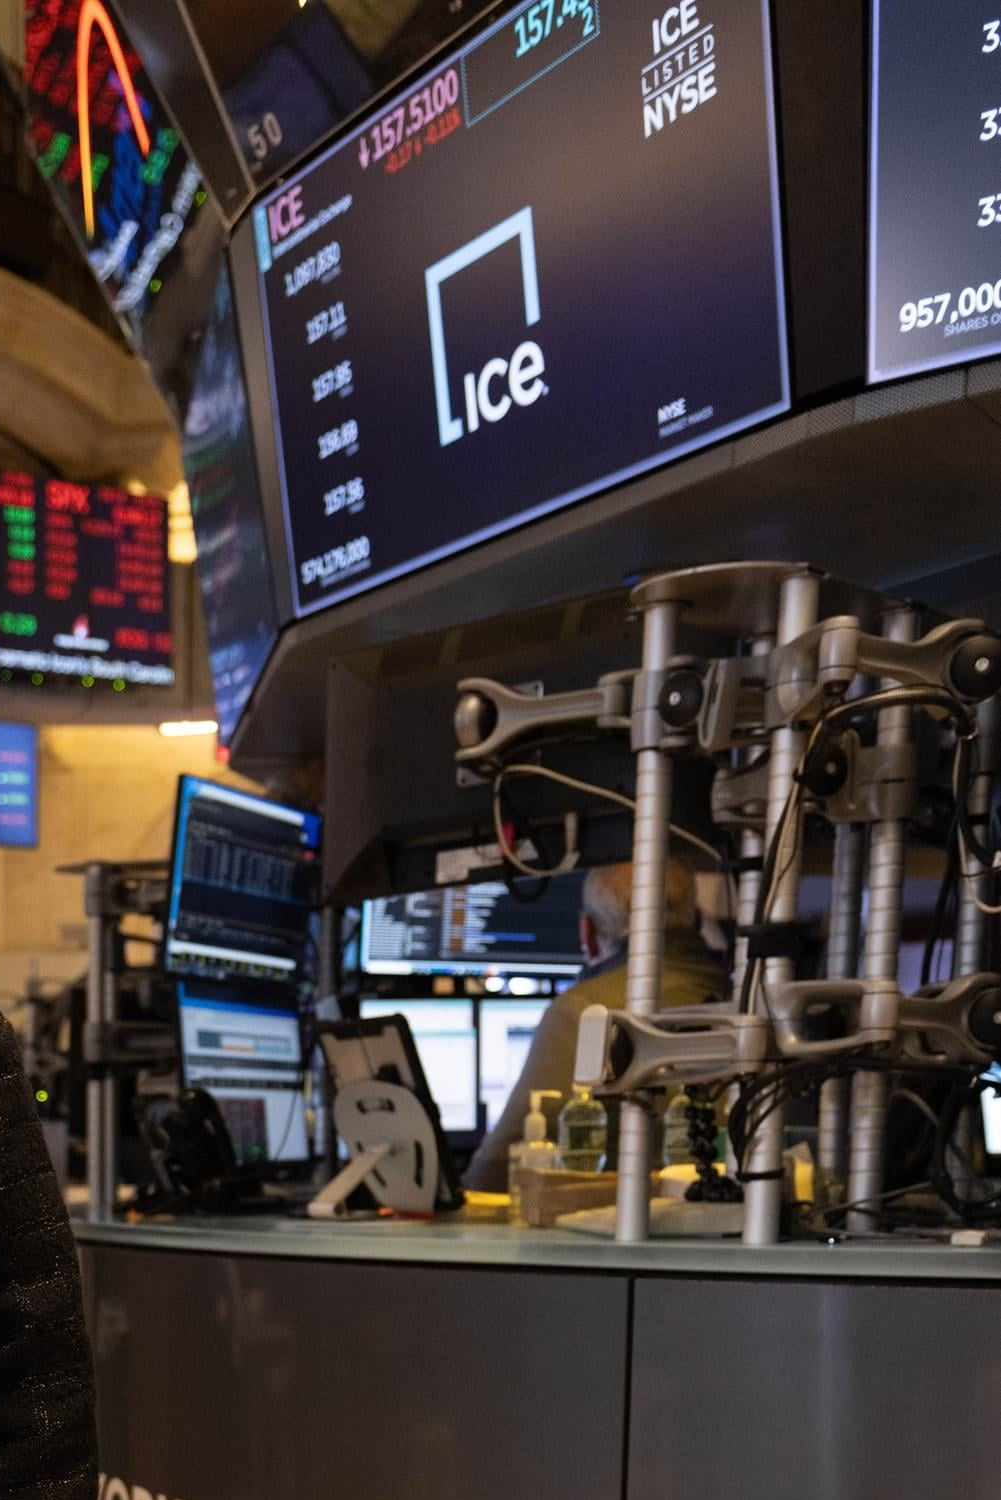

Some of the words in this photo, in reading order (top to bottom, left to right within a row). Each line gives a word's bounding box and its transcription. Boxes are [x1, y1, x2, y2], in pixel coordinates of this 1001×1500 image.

[652, 0, 701, 55] ICE
[981, 20, 1001, 53] 3
[641, 33, 715, 97] LISTED
[371, 69, 459, 162] 157.5100
[643, 62, 718, 139] NYSE
[979, 107, 1001, 141] 3
[247, 112, 283, 159] 50
[267, 184, 306, 244] ICE
[944, 315, 988, 337] SHARES
[657, 396, 687, 425] NYSE
